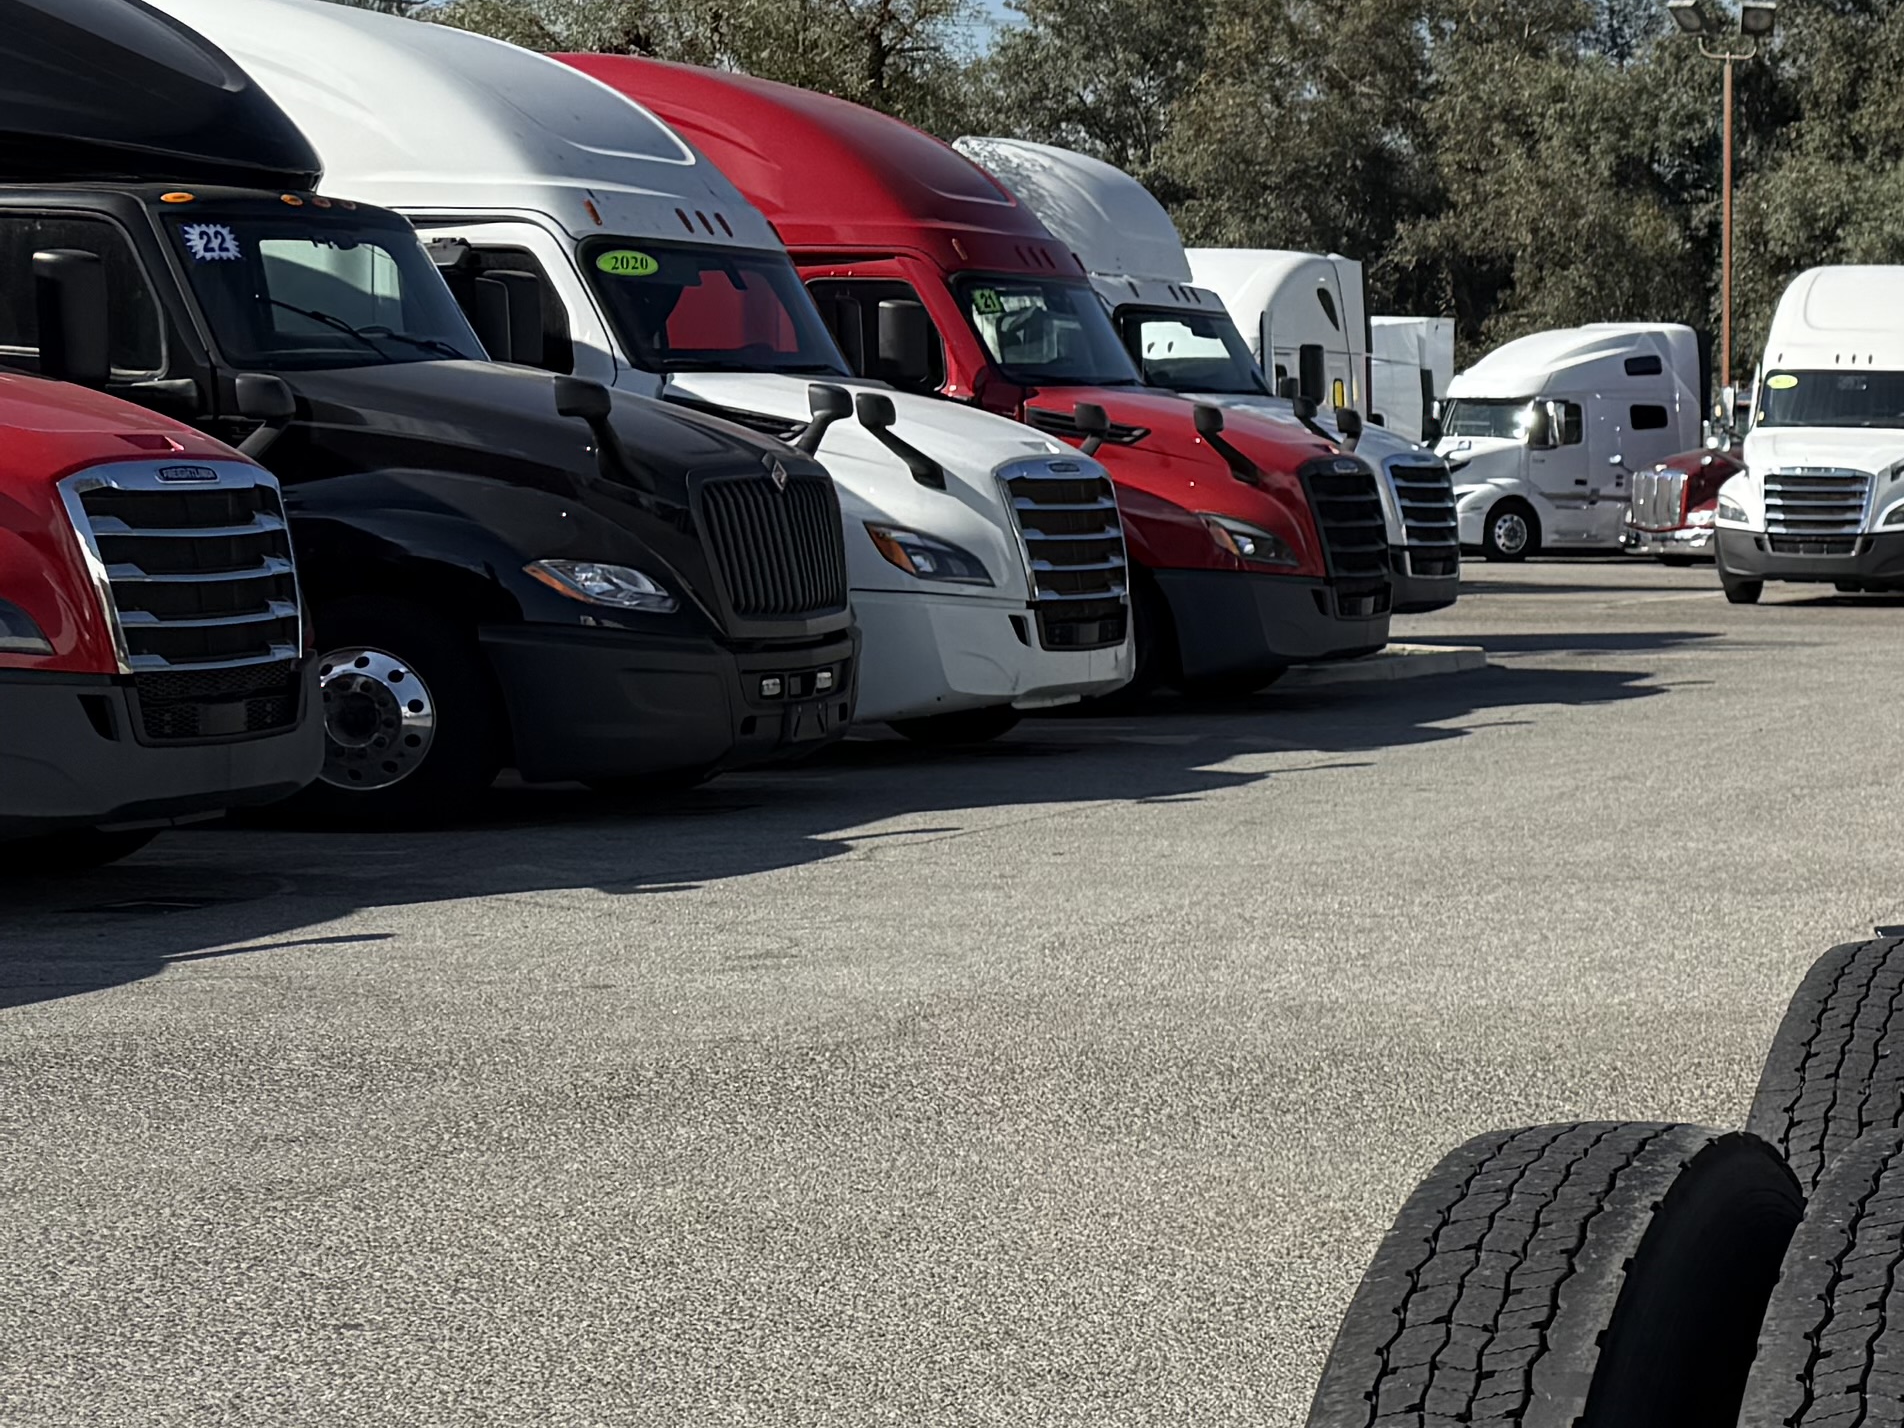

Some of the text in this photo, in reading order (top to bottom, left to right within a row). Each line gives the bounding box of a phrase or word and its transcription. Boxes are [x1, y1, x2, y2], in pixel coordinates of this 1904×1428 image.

[198, 230, 231, 253] 22
[610, 255, 649, 271] 2020
[979, 292, 997, 309] 21
